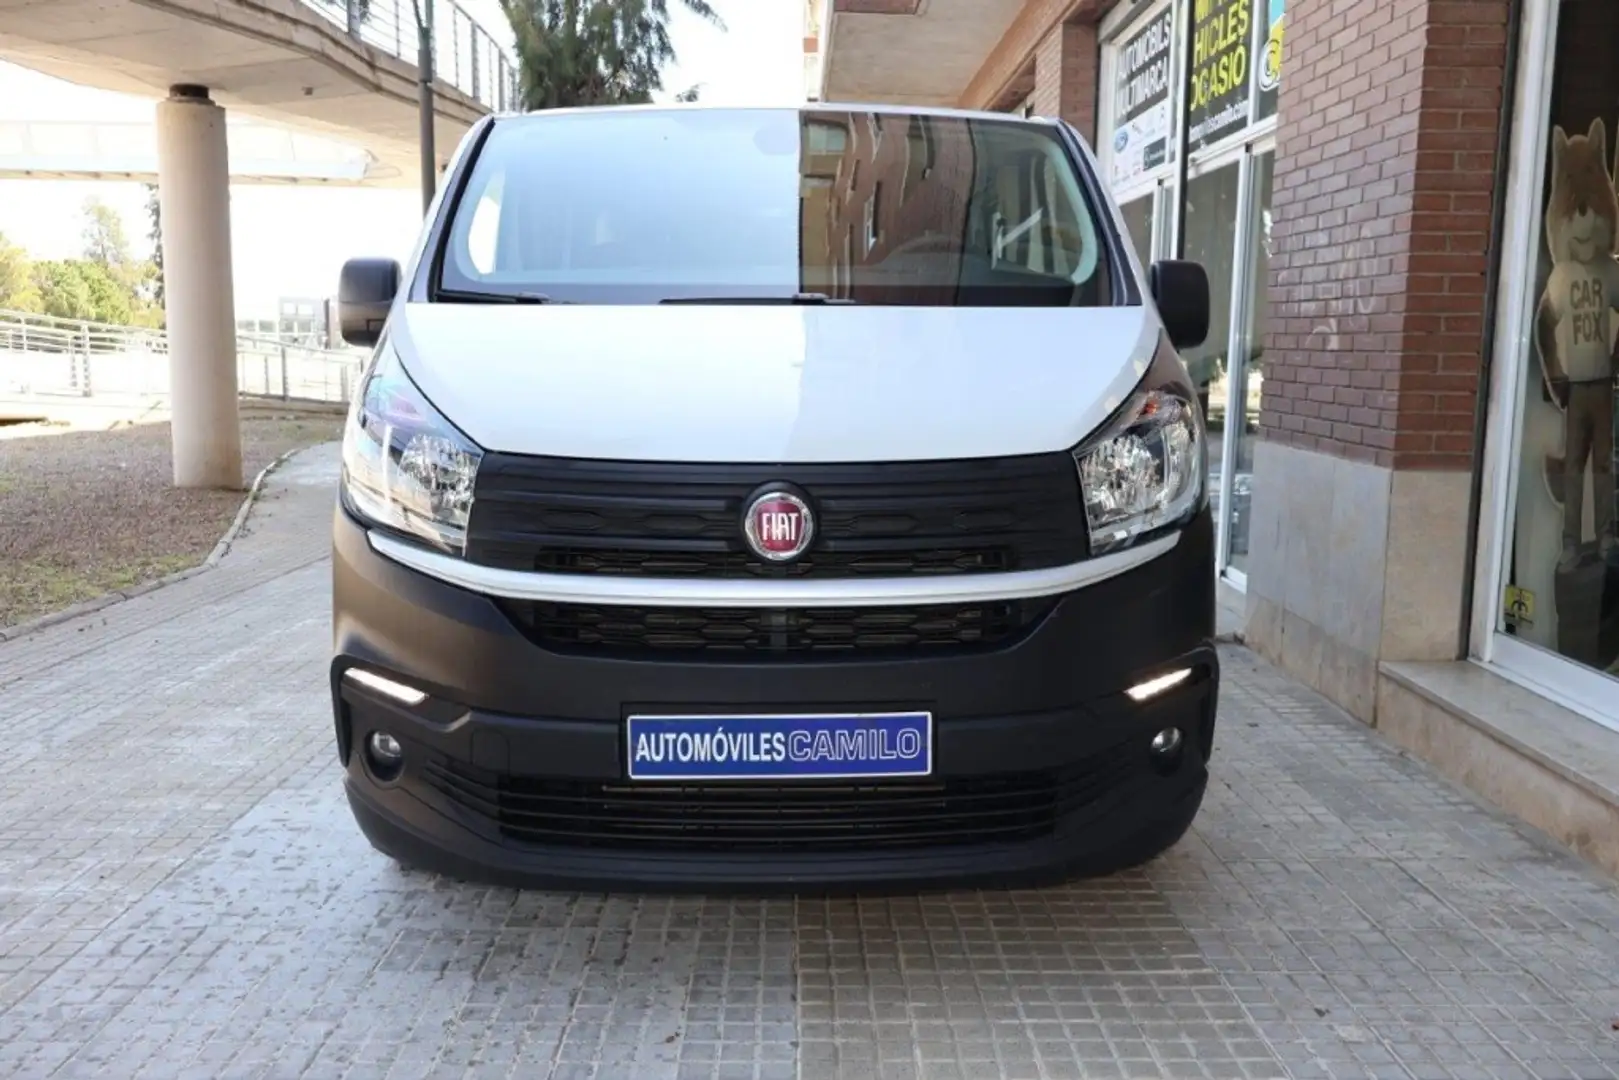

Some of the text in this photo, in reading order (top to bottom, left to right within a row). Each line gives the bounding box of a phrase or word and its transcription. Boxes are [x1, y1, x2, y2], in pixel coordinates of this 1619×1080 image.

[1570, 278, 1603, 310] CAR
[1573, 312, 1604, 345] FOX
[762, 512, 799, 541] FIAT
[635, 727, 921, 762] AUTOMÓVILES CAMILO
